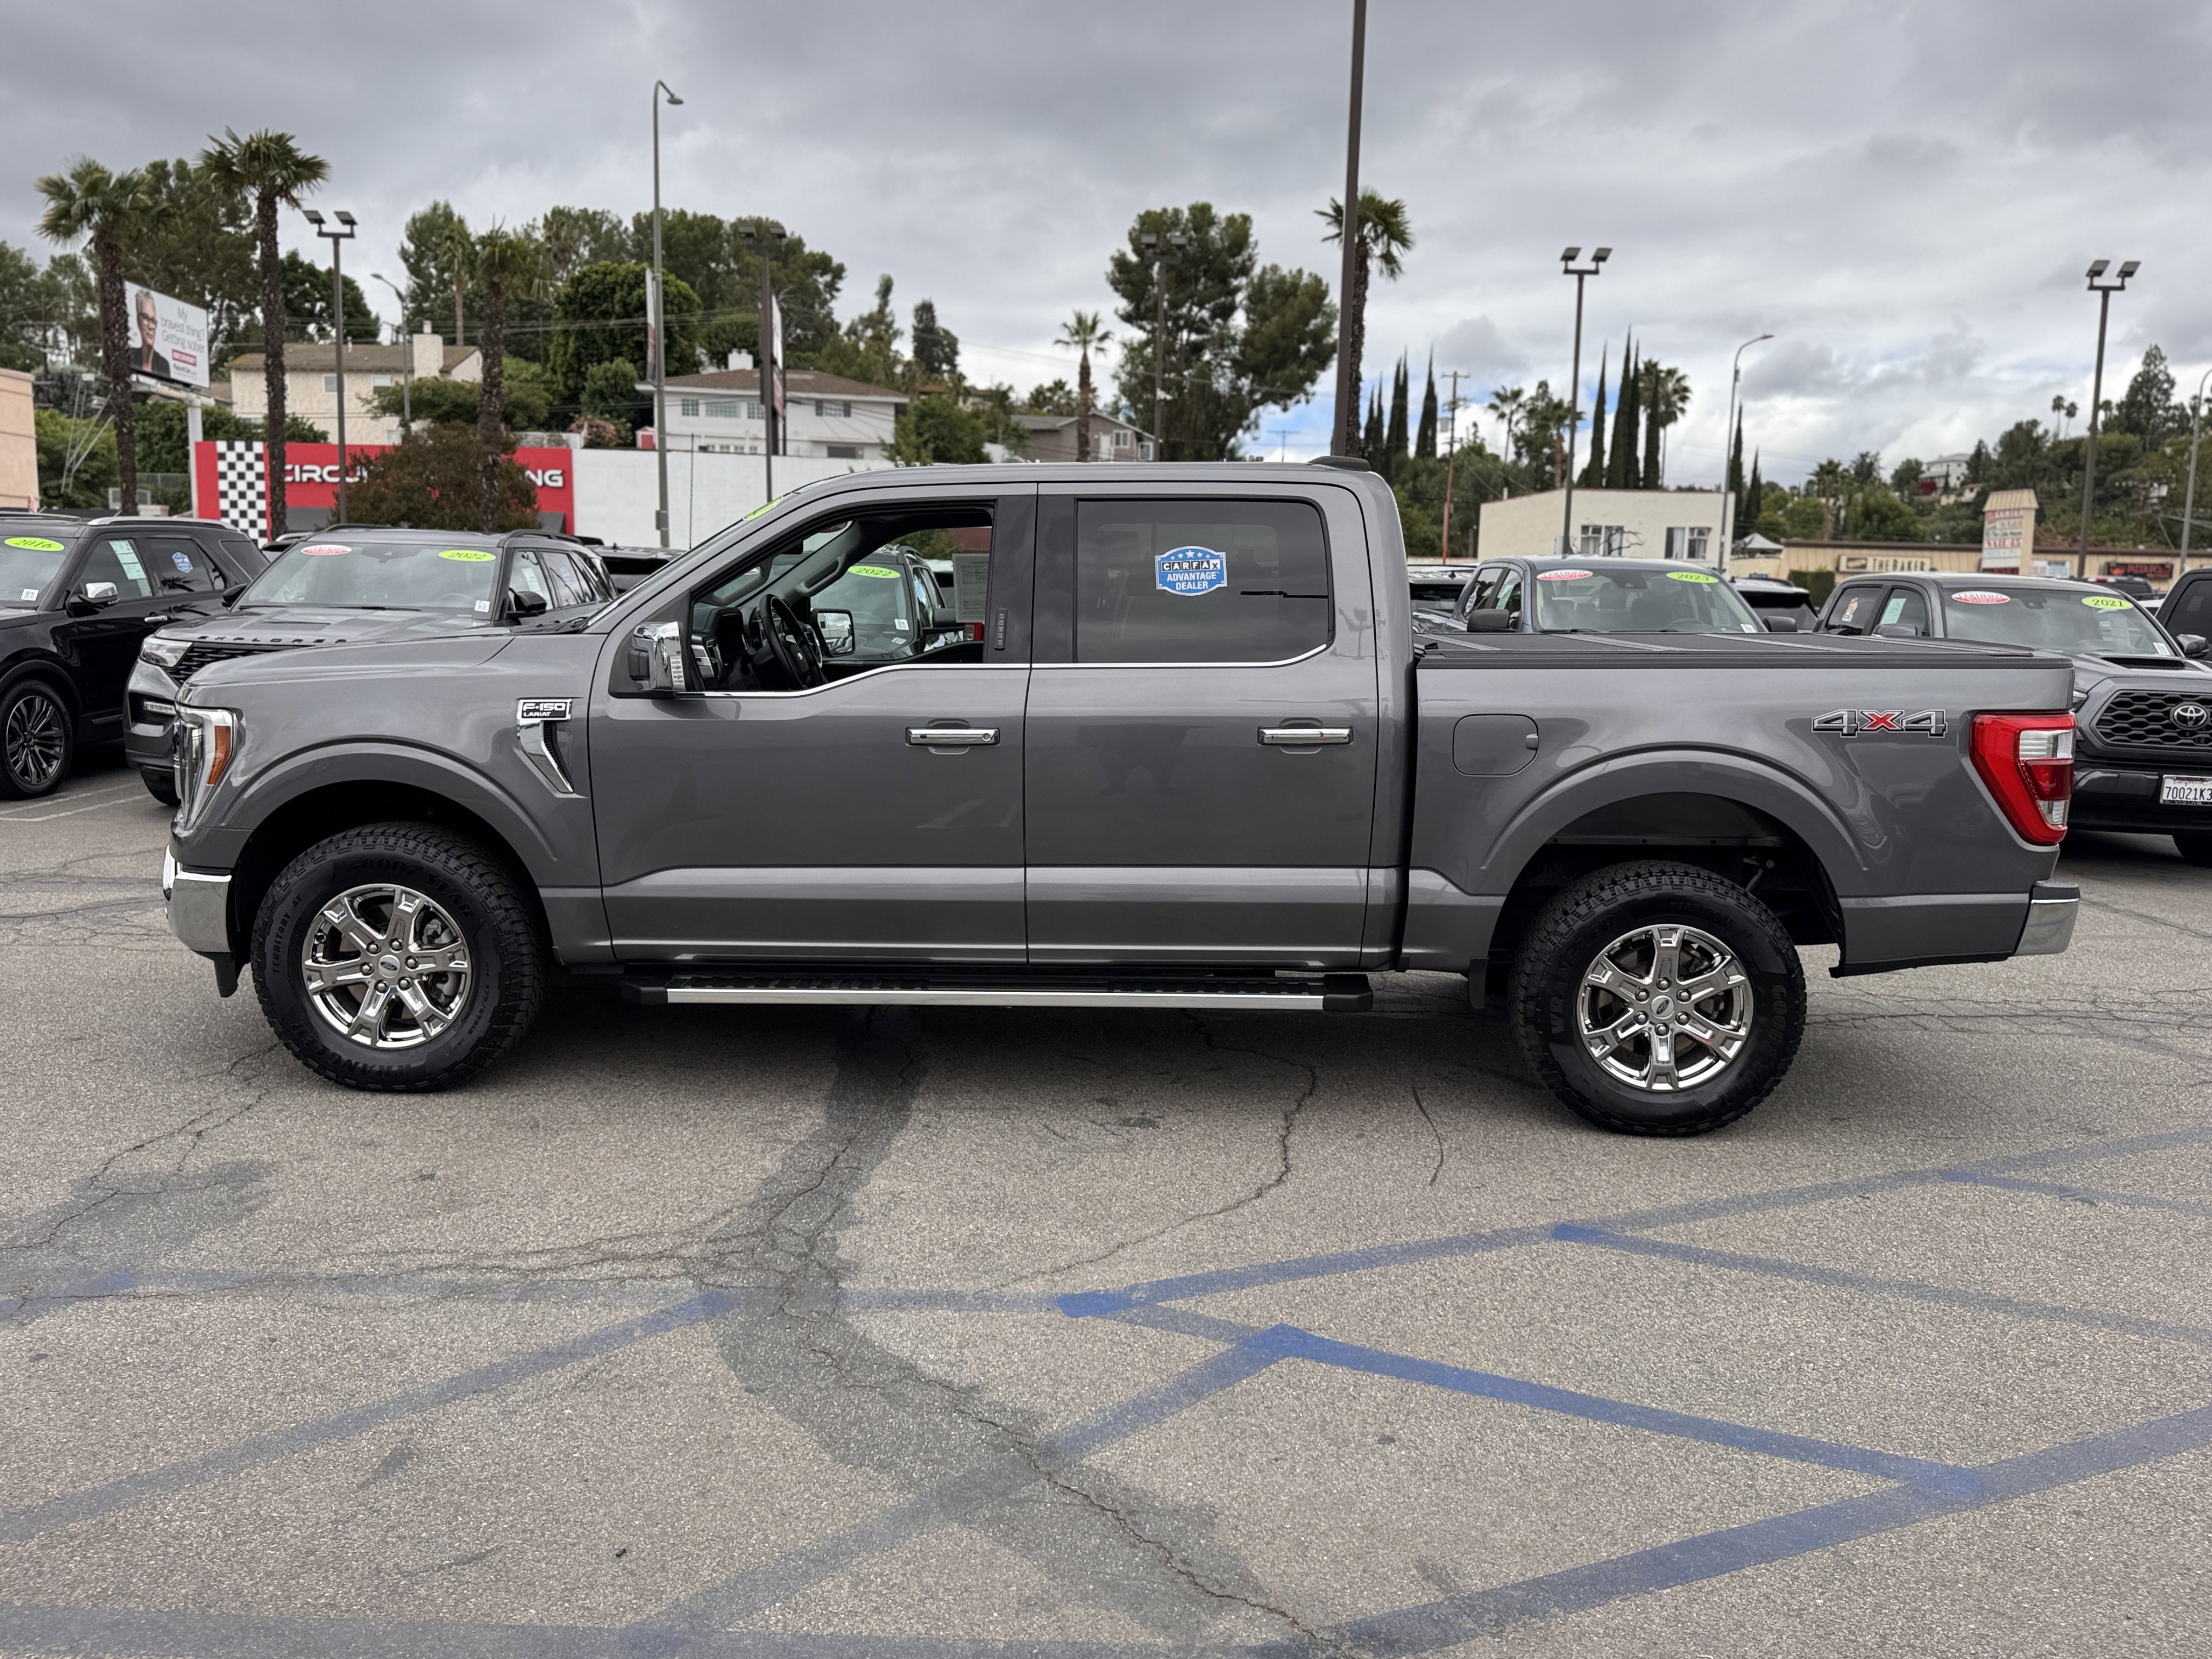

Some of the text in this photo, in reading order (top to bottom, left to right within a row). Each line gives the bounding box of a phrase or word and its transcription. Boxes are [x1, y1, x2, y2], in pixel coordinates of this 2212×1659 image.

[178, 307, 188, 323] My
[161, 315, 205, 341] bravest thing?
[162, 329, 186, 350] Getting
[173, 351, 196, 364] RECOVERY
[13, 539, 54, 549] 2016
[1163, 561, 1219, 571] CARFAX
[1872, 558, 1889, 571] THE
[1893, 559, 1925, 572] BAKER
[856, 568, 892, 576] 2022
[1167, 572, 1217, 582] ADVANTAGE
[1176, 581, 1209, 590] DEALER
[198, 635, 347, 644] EXPLORER
[523, 703, 566, 711] F-150
[273, 911, 291, 973] TERRITORY
